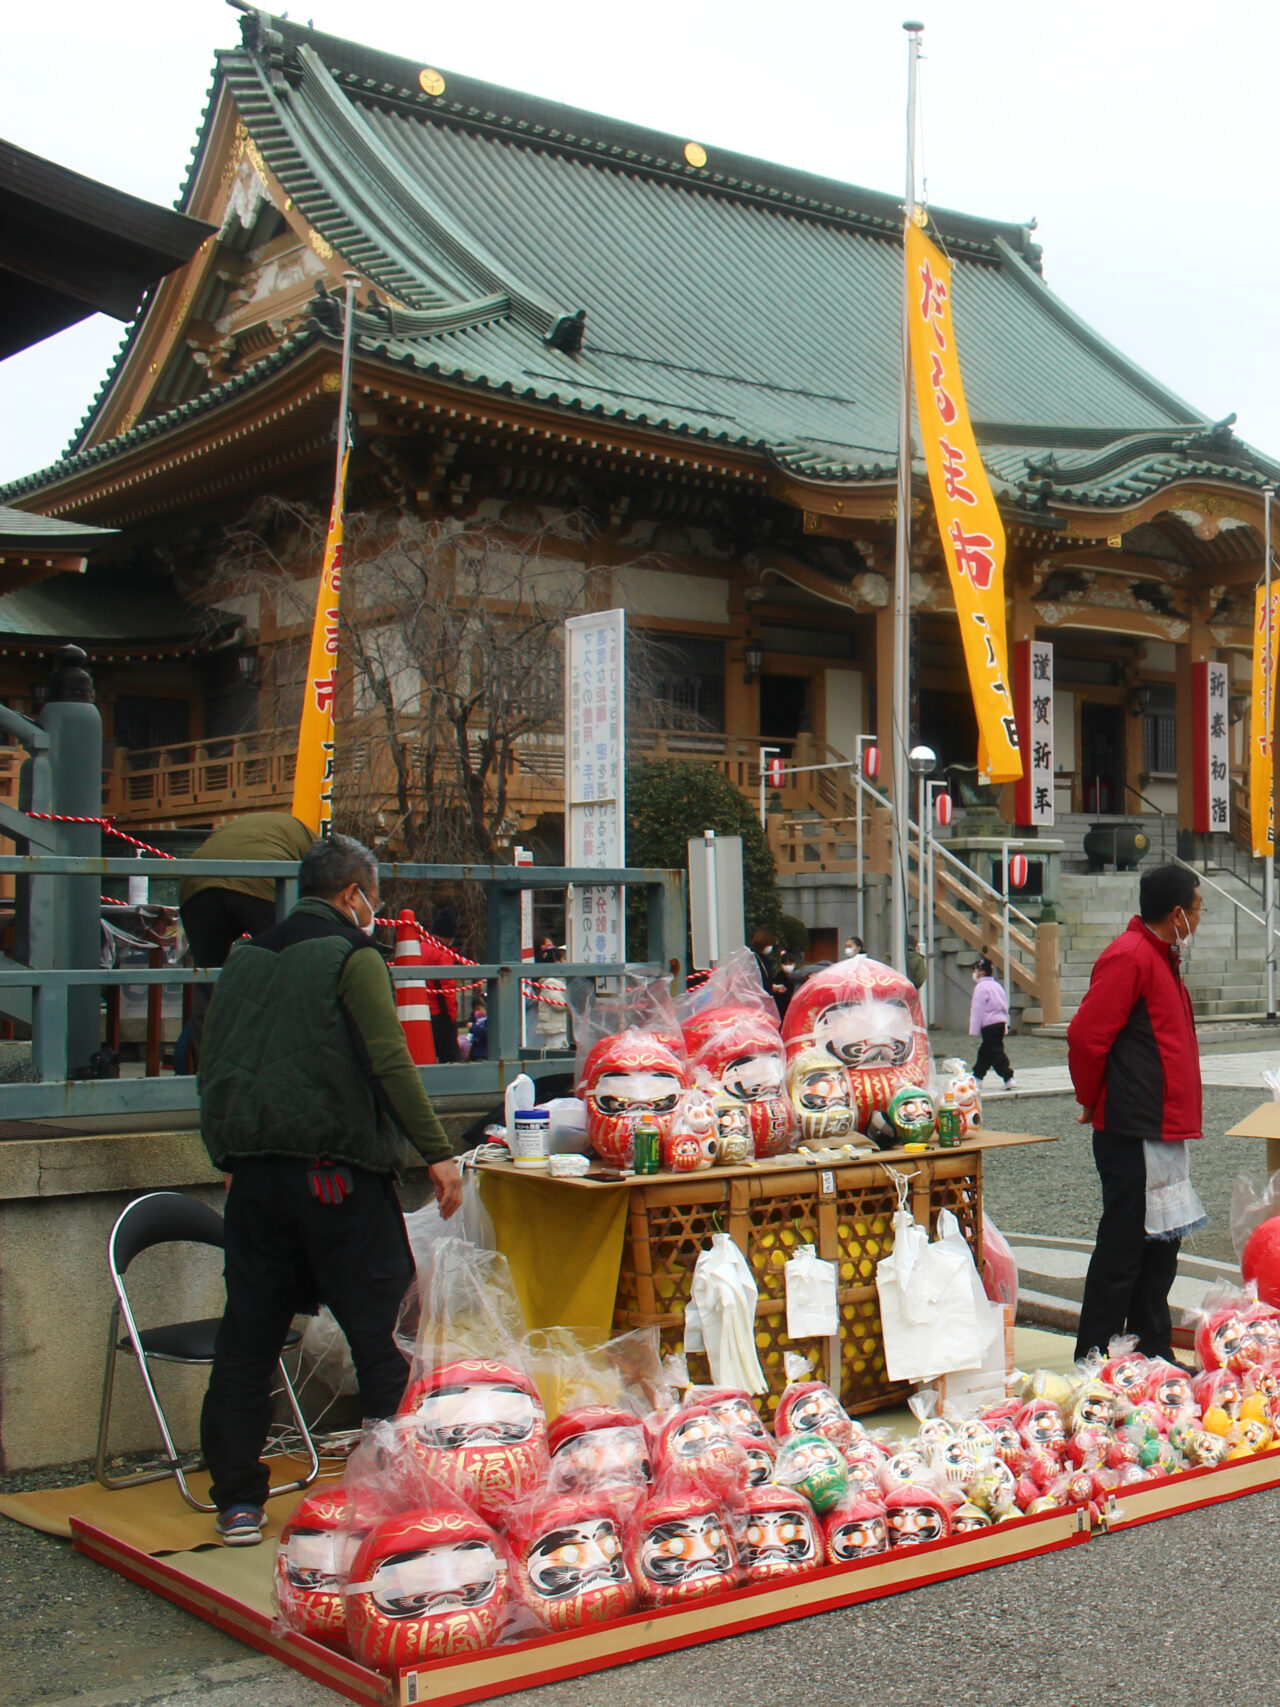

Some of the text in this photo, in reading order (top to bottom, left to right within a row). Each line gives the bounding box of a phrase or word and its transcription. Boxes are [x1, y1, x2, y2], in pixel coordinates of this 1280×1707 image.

[919, 257, 996, 591] だるま市
[1033, 652, 1052, 815] 謹賀新年
[1209, 671, 1227, 824] 新春初詣
[467, 1452, 512, 1490] 福
[428, 1613, 478, 1657] 福
[586, 1585, 624, 1622] 福
